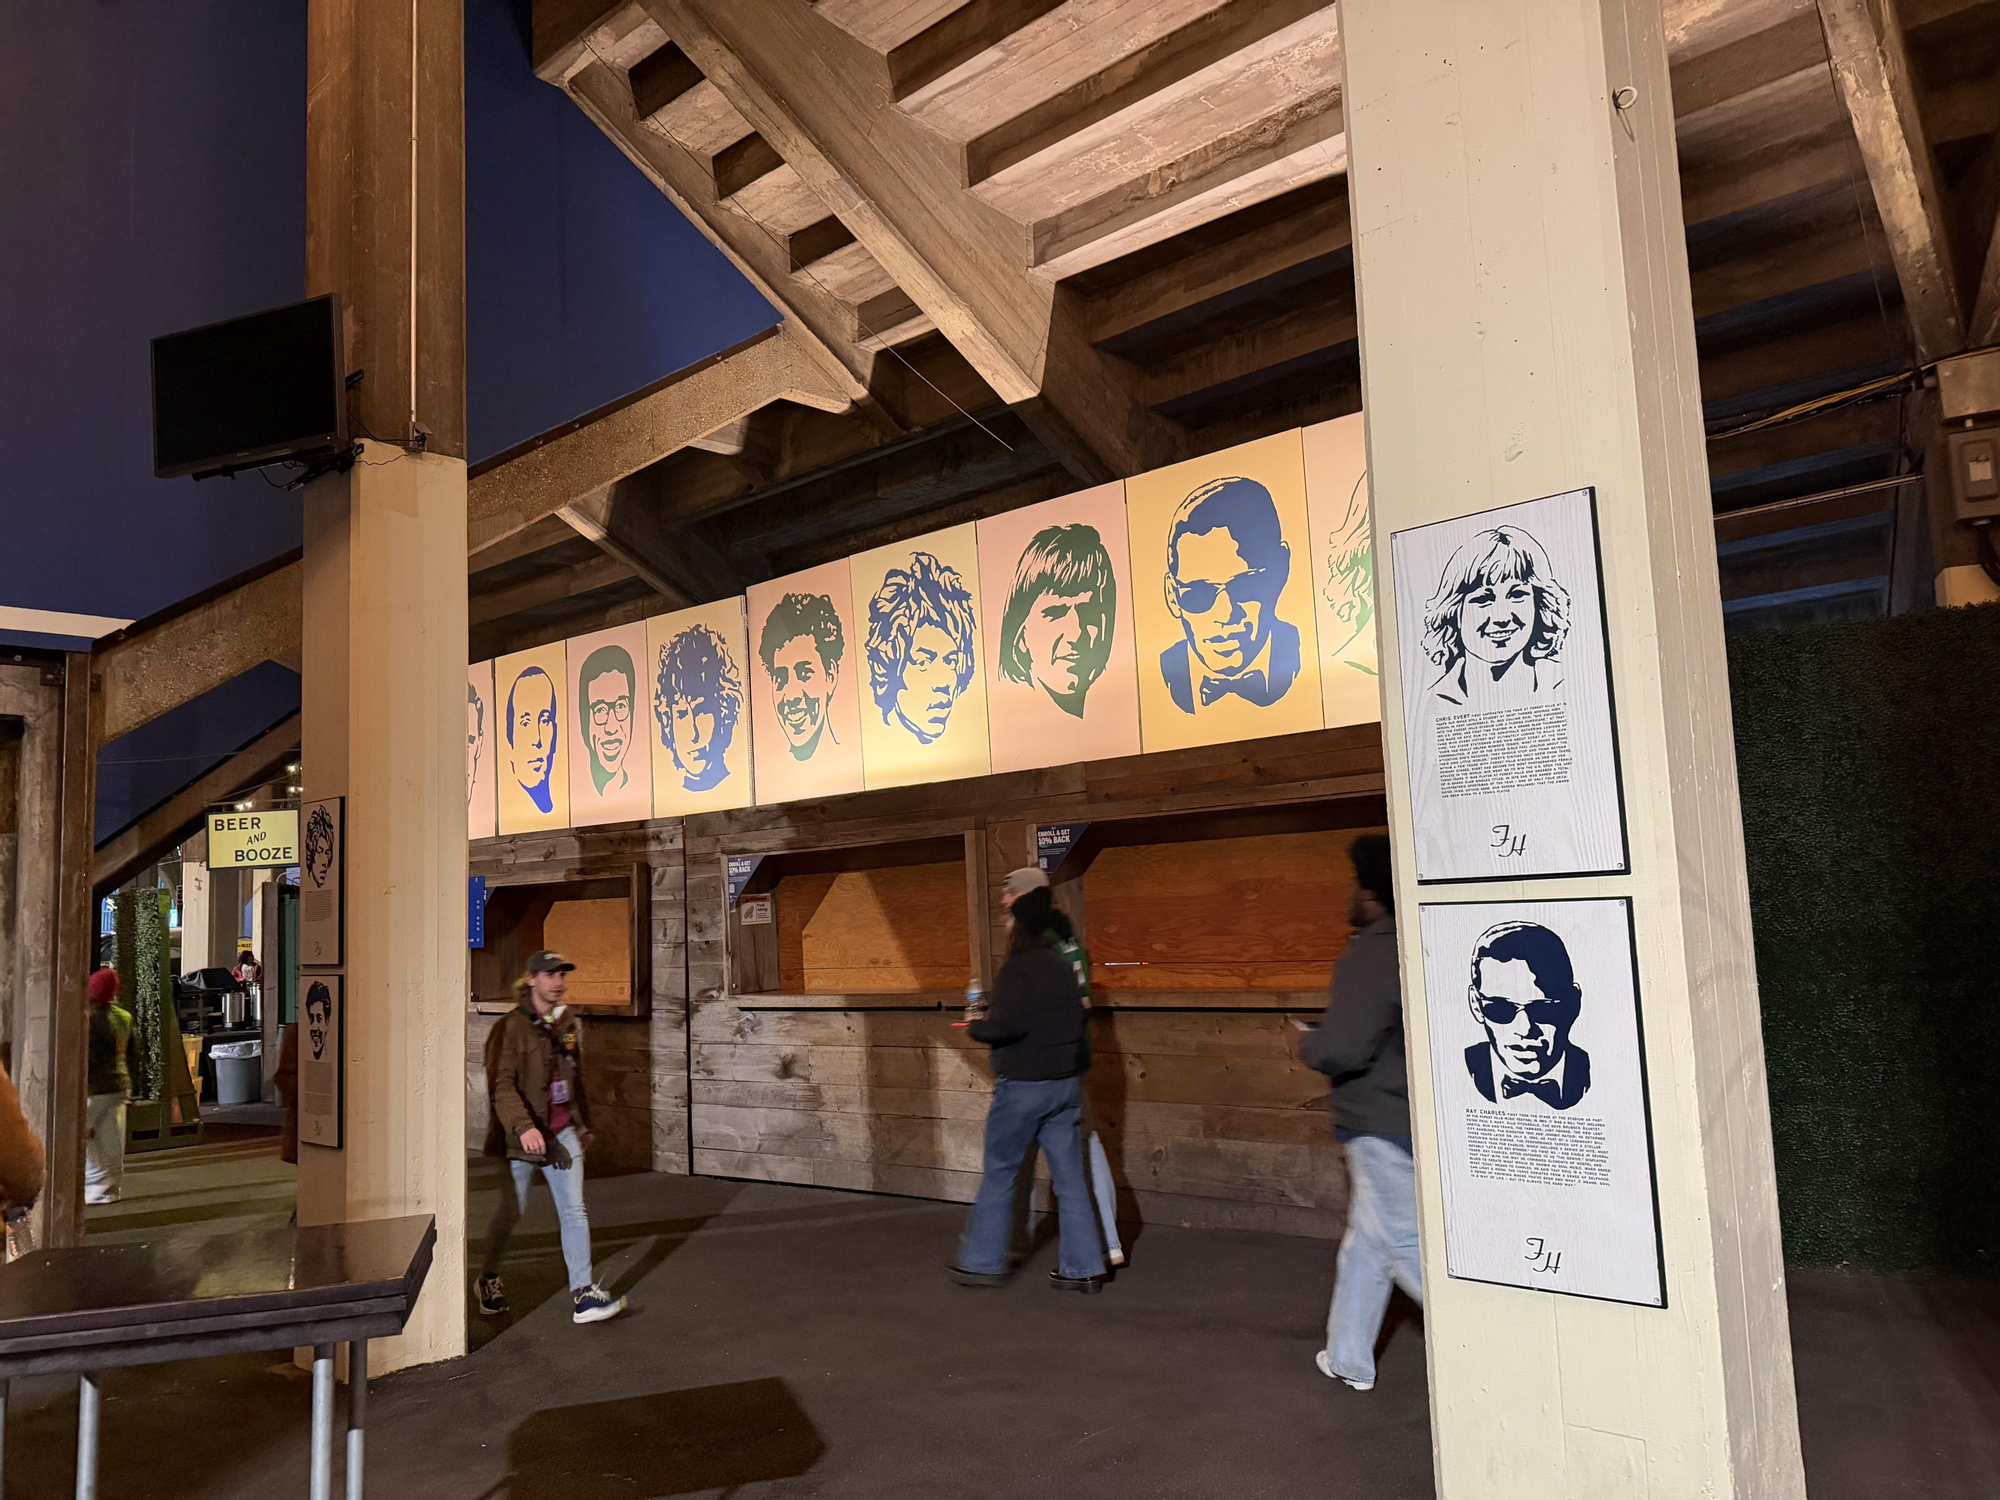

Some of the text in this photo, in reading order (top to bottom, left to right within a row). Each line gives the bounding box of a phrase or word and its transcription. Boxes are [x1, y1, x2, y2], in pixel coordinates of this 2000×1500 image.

[215, 817, 261, 831] BEER
[247, 832, 267, 845] AND
[235, 847, 292, 862] BOOZE
